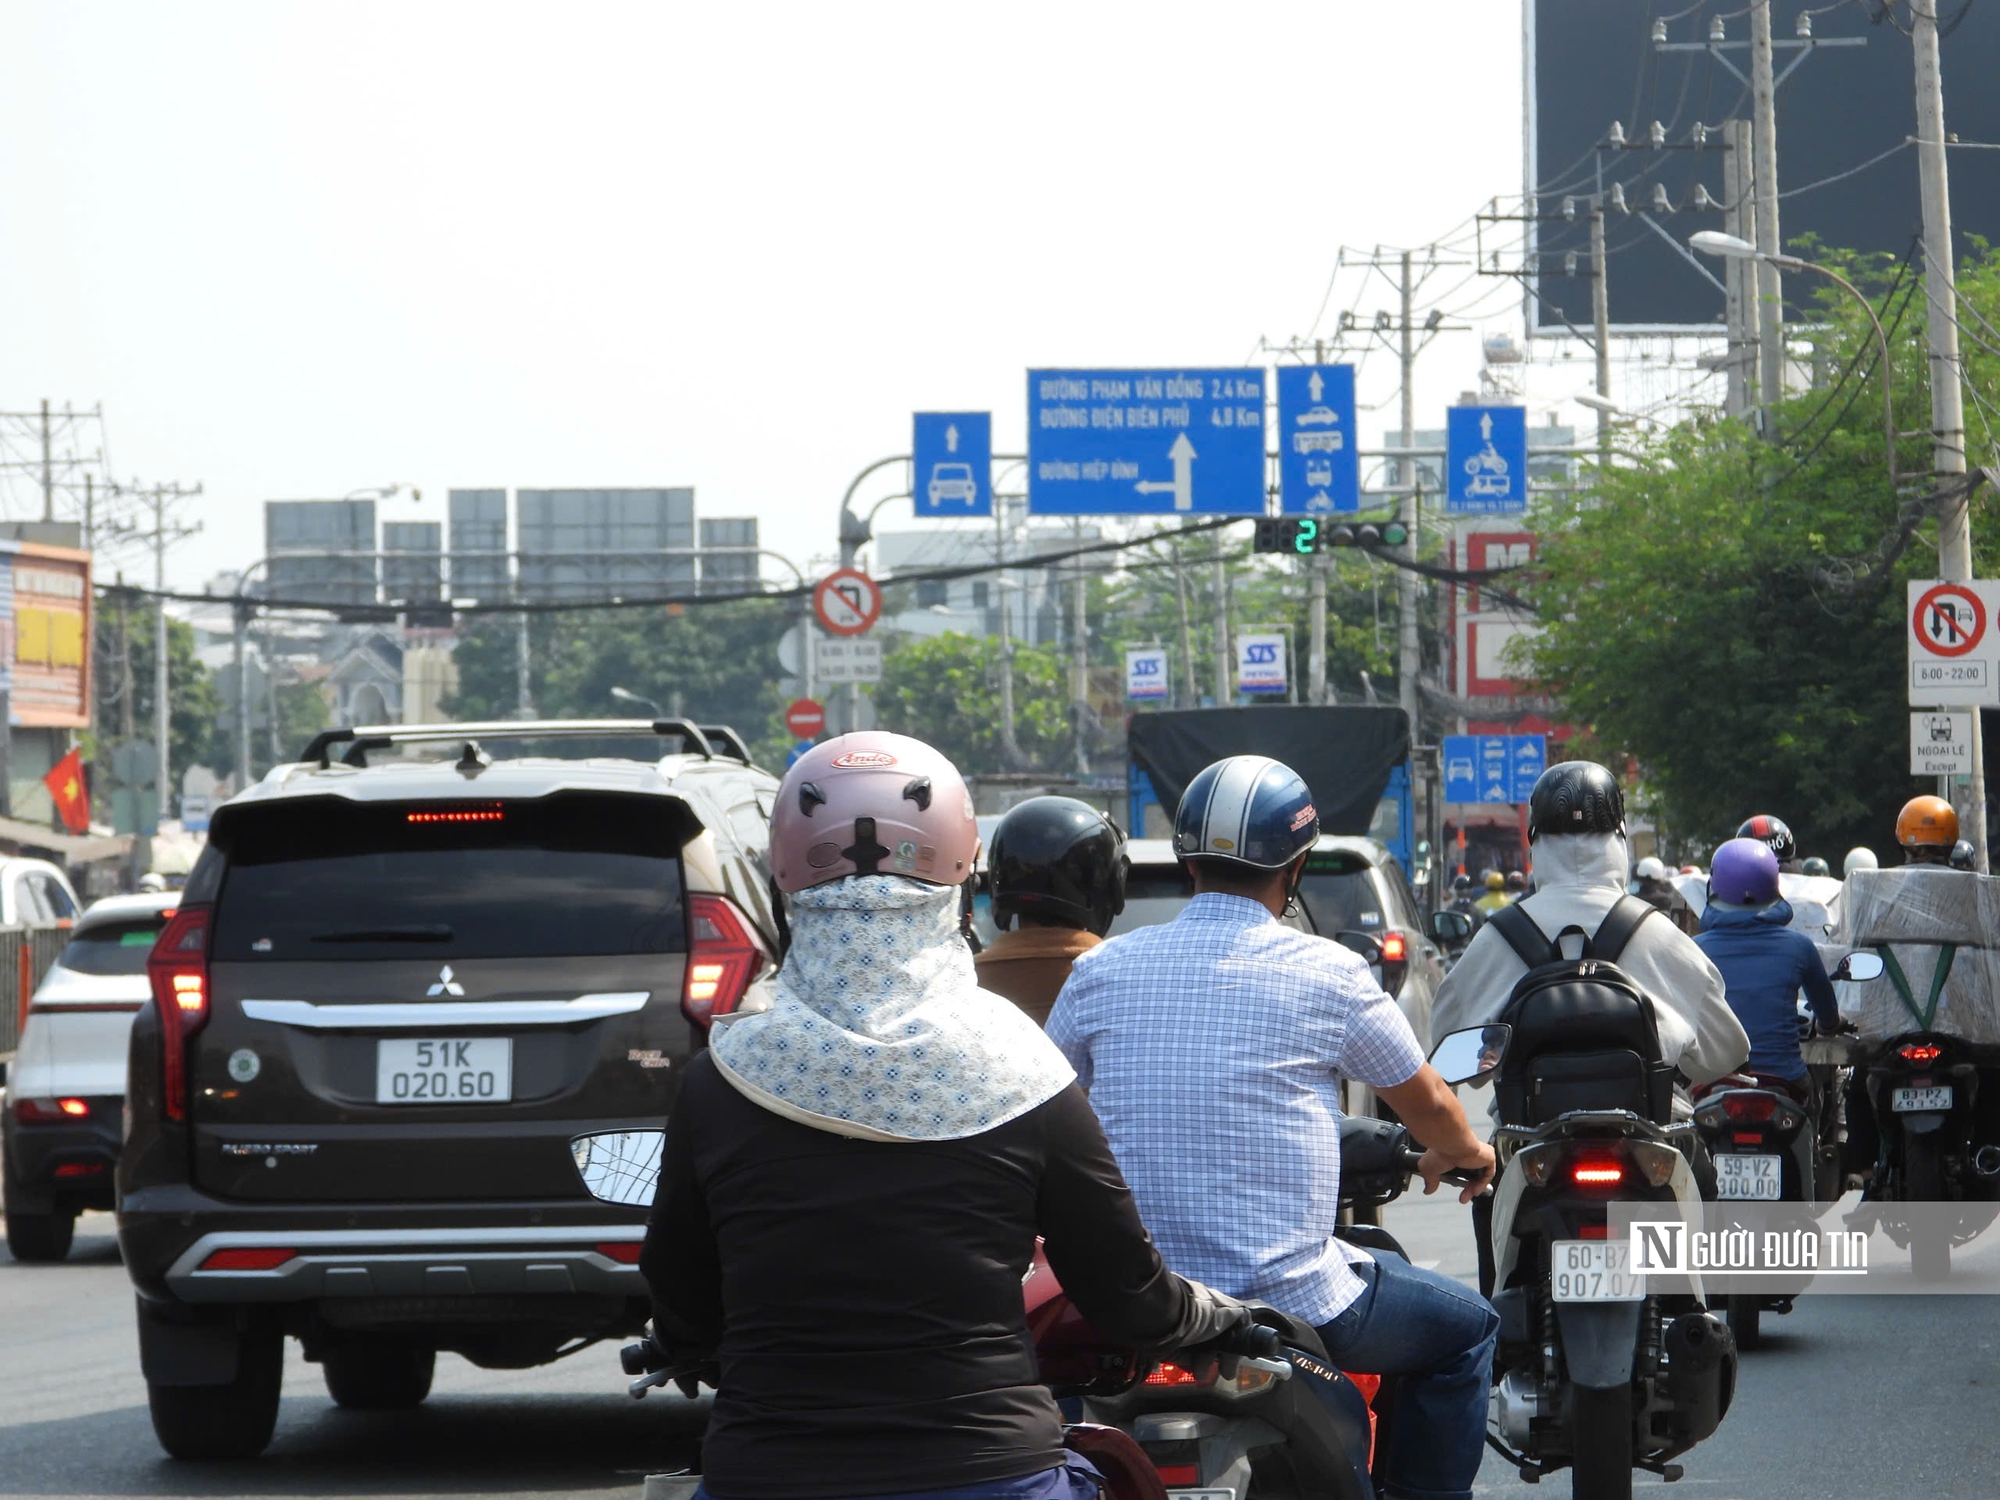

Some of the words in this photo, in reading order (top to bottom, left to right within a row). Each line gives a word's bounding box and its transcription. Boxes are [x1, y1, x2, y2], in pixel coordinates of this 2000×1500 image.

[1236, 379, 1260, 399] Km
[1236, 407, 1260, 428] Km
[1294, 519, 1317, 553] 2
[1951, 667, 1979, 680] 22:00
[1925, 761, 1957, 773] Except
[416, 1041, 472, 1068] 51K
[392, 1071, 494, 1098] 020.60
[1724, 1158, 1771, 1177] 59-V2
[1718, 1177, 1777, 1197] 300.00
[1557, 1272, 1640, 1298] 907.07
